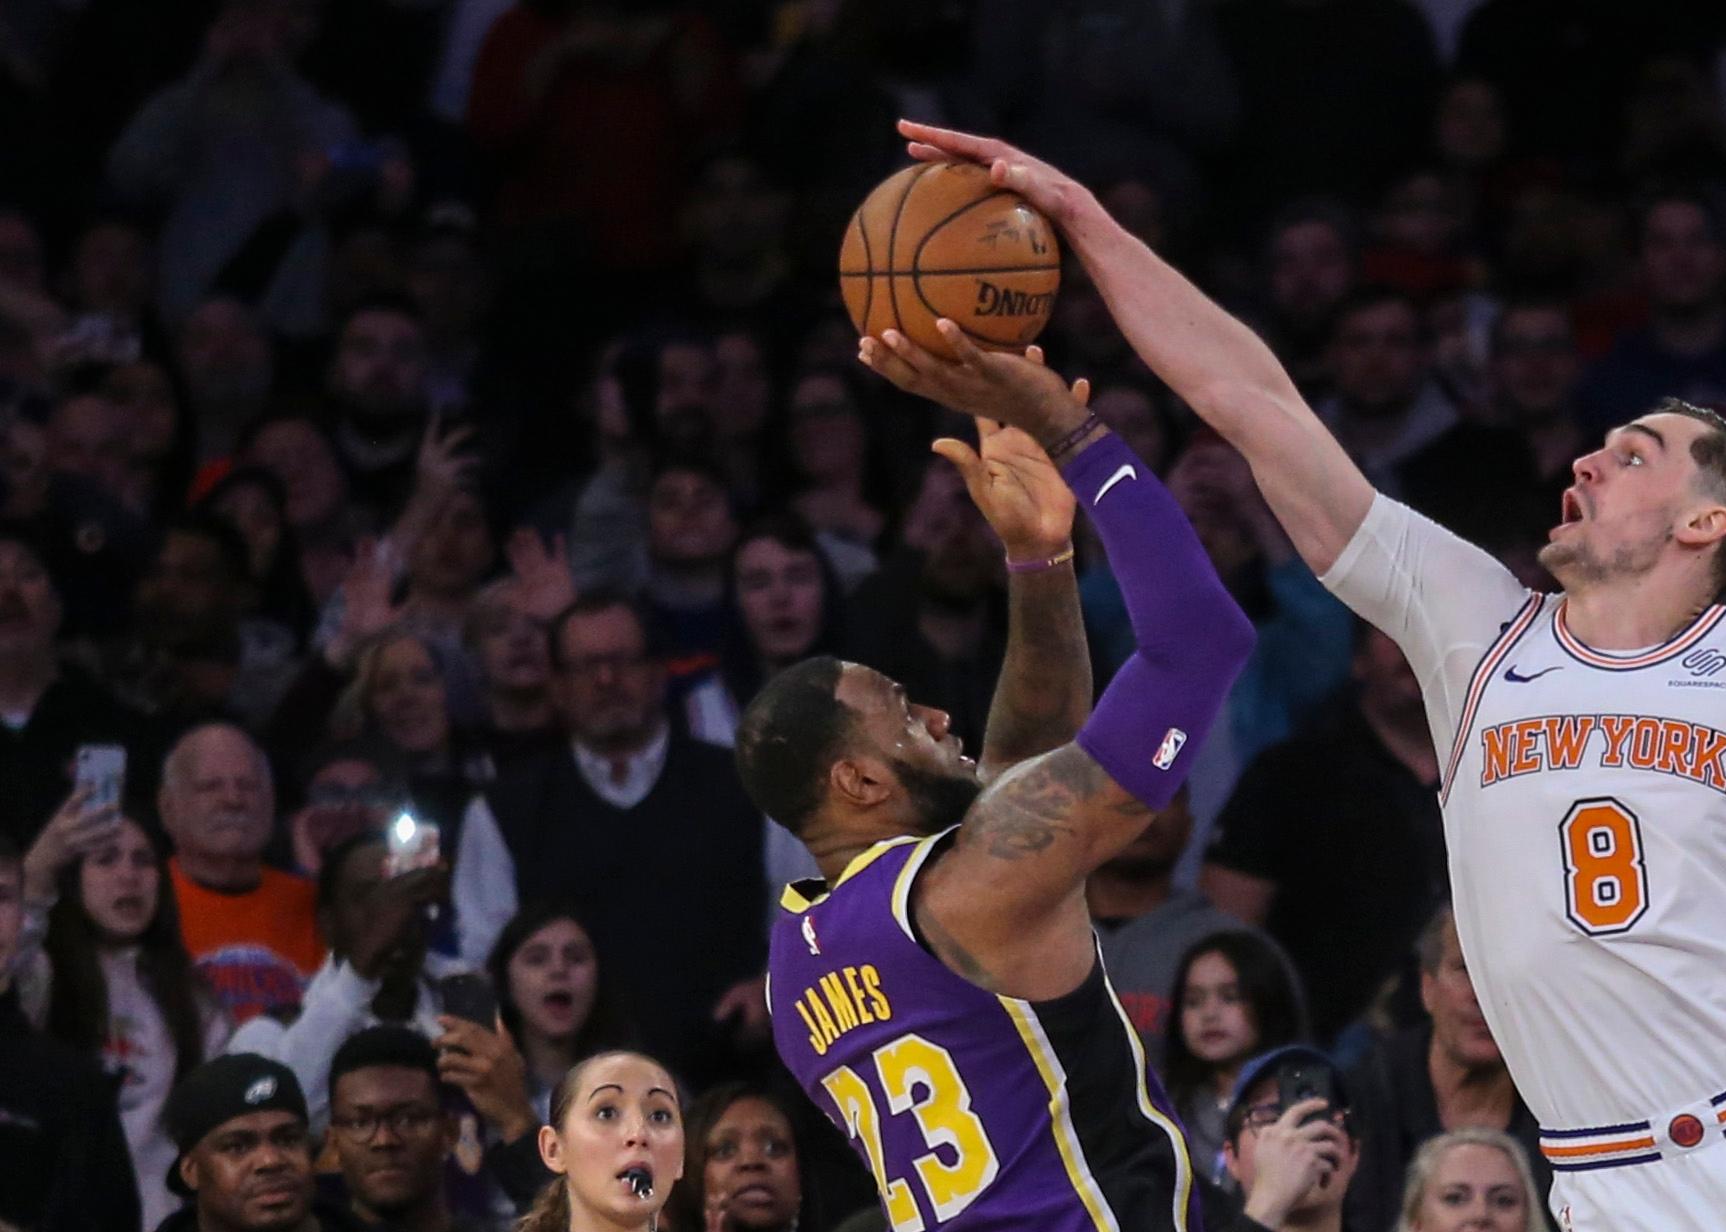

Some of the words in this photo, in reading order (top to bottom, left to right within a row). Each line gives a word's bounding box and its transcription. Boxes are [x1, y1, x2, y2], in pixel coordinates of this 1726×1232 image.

[1481, 715, 1595, 789] NEW
[1558, 796, 1649, 937] 8
[794, 963, 892, 1056] JAMES
